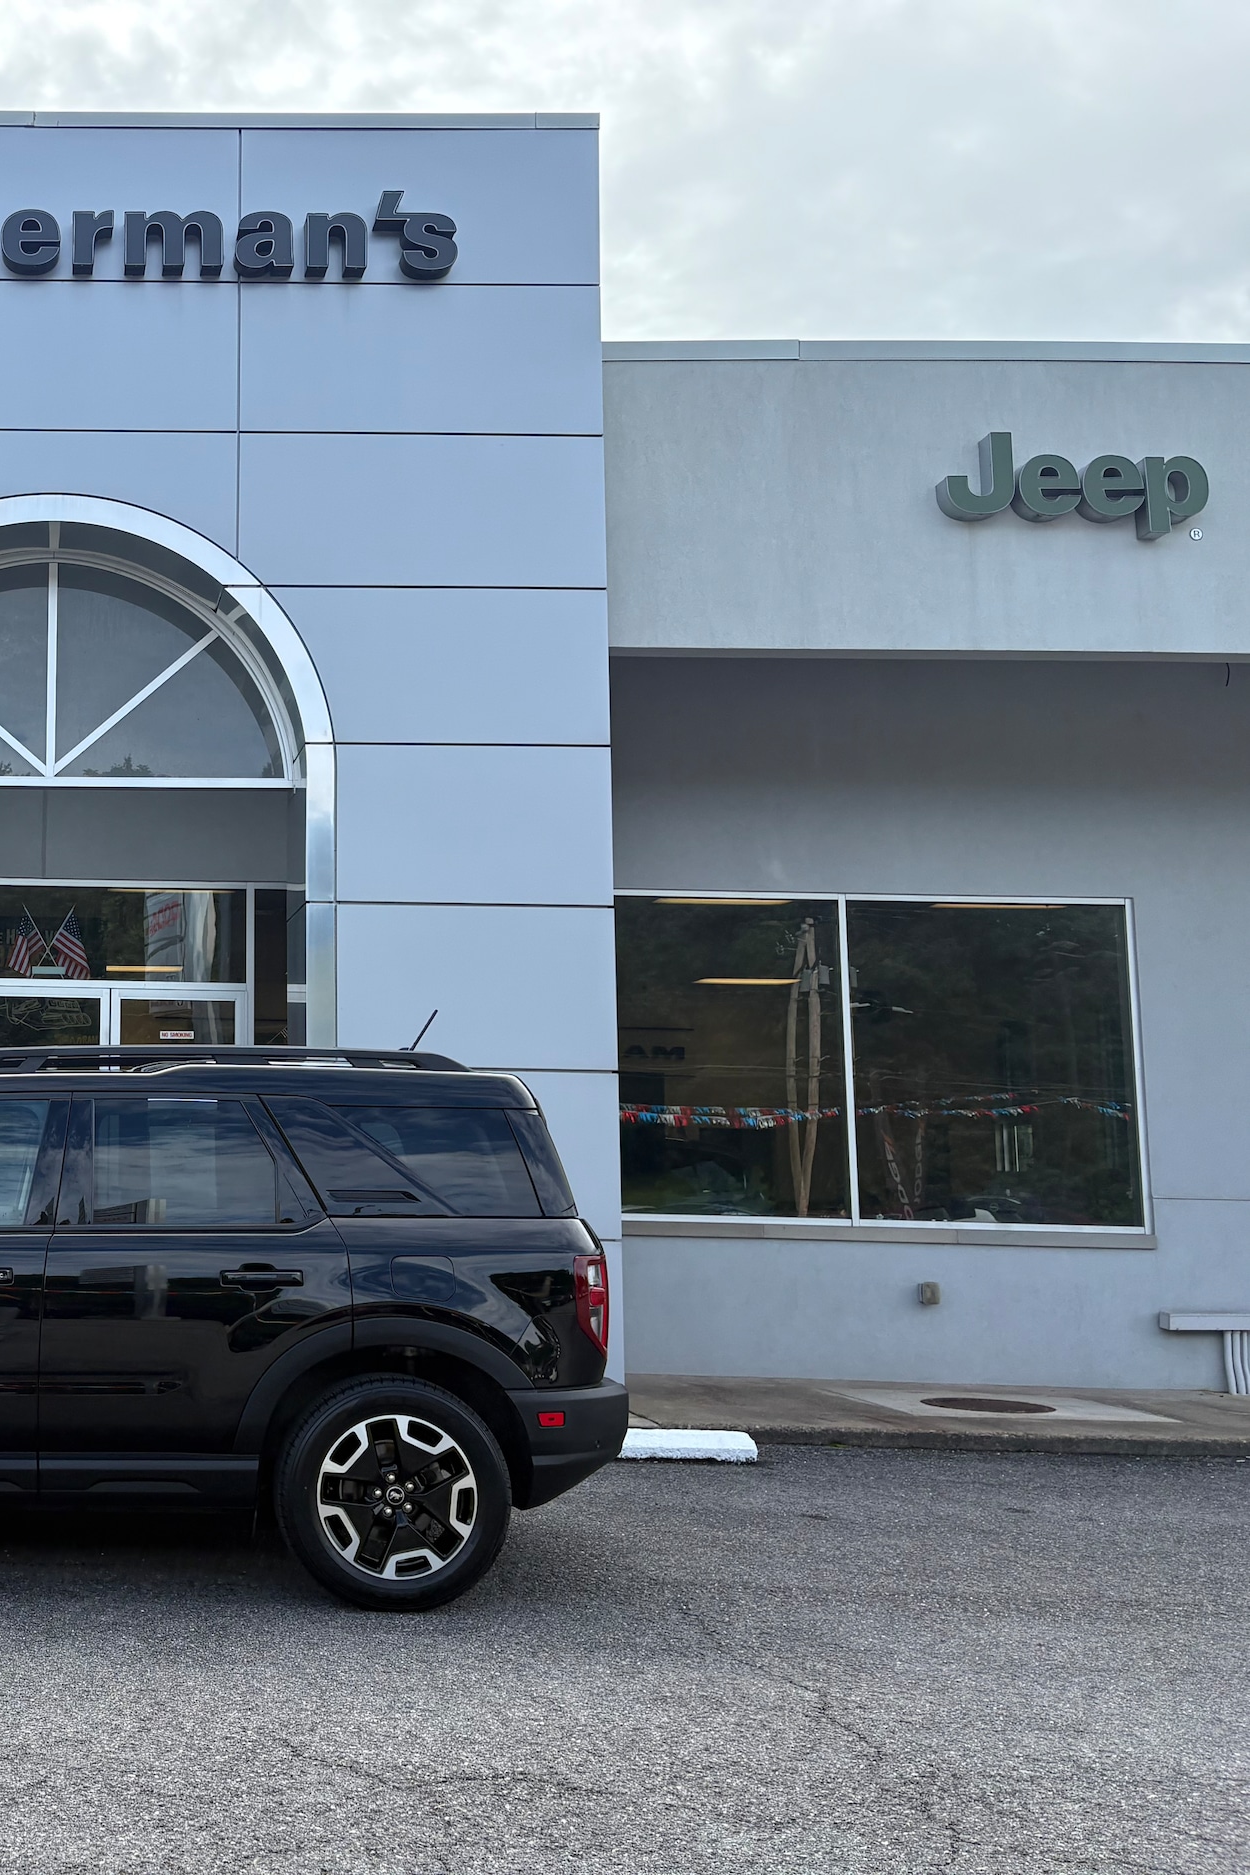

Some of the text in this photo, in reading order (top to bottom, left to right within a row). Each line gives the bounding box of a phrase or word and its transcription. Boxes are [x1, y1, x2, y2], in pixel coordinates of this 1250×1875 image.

[935, 431, 1210, 540] Jeep
[622, 1044, 685, 1060] AM
[884, 1141, 914, 1220] ODGE
